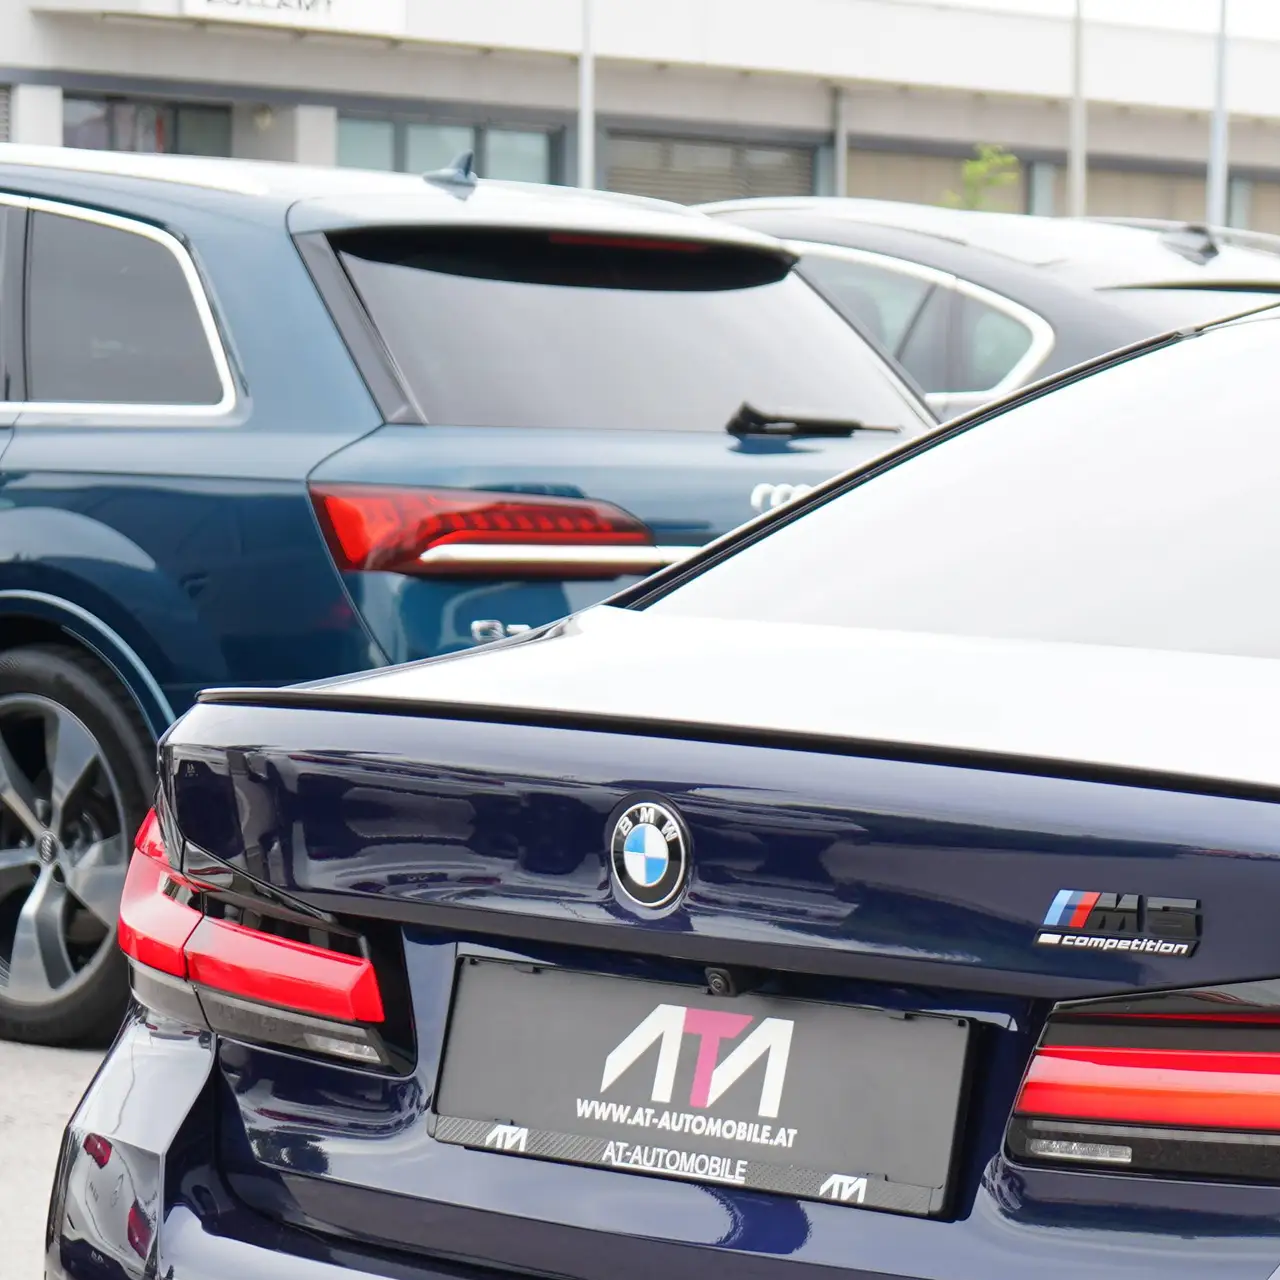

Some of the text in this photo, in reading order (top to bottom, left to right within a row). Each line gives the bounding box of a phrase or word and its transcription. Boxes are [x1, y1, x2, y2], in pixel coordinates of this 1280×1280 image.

[618, 806, 680, 842] BMW
[1083, 892, 1203, 937] M5
[1061, 935, 1188, 955] competition
[576, 1098, 798, 1148] WWW.AT-AUTOMOBILE.AT
[602, 1141, 748, 1181] AT-AUTOMOBILE
